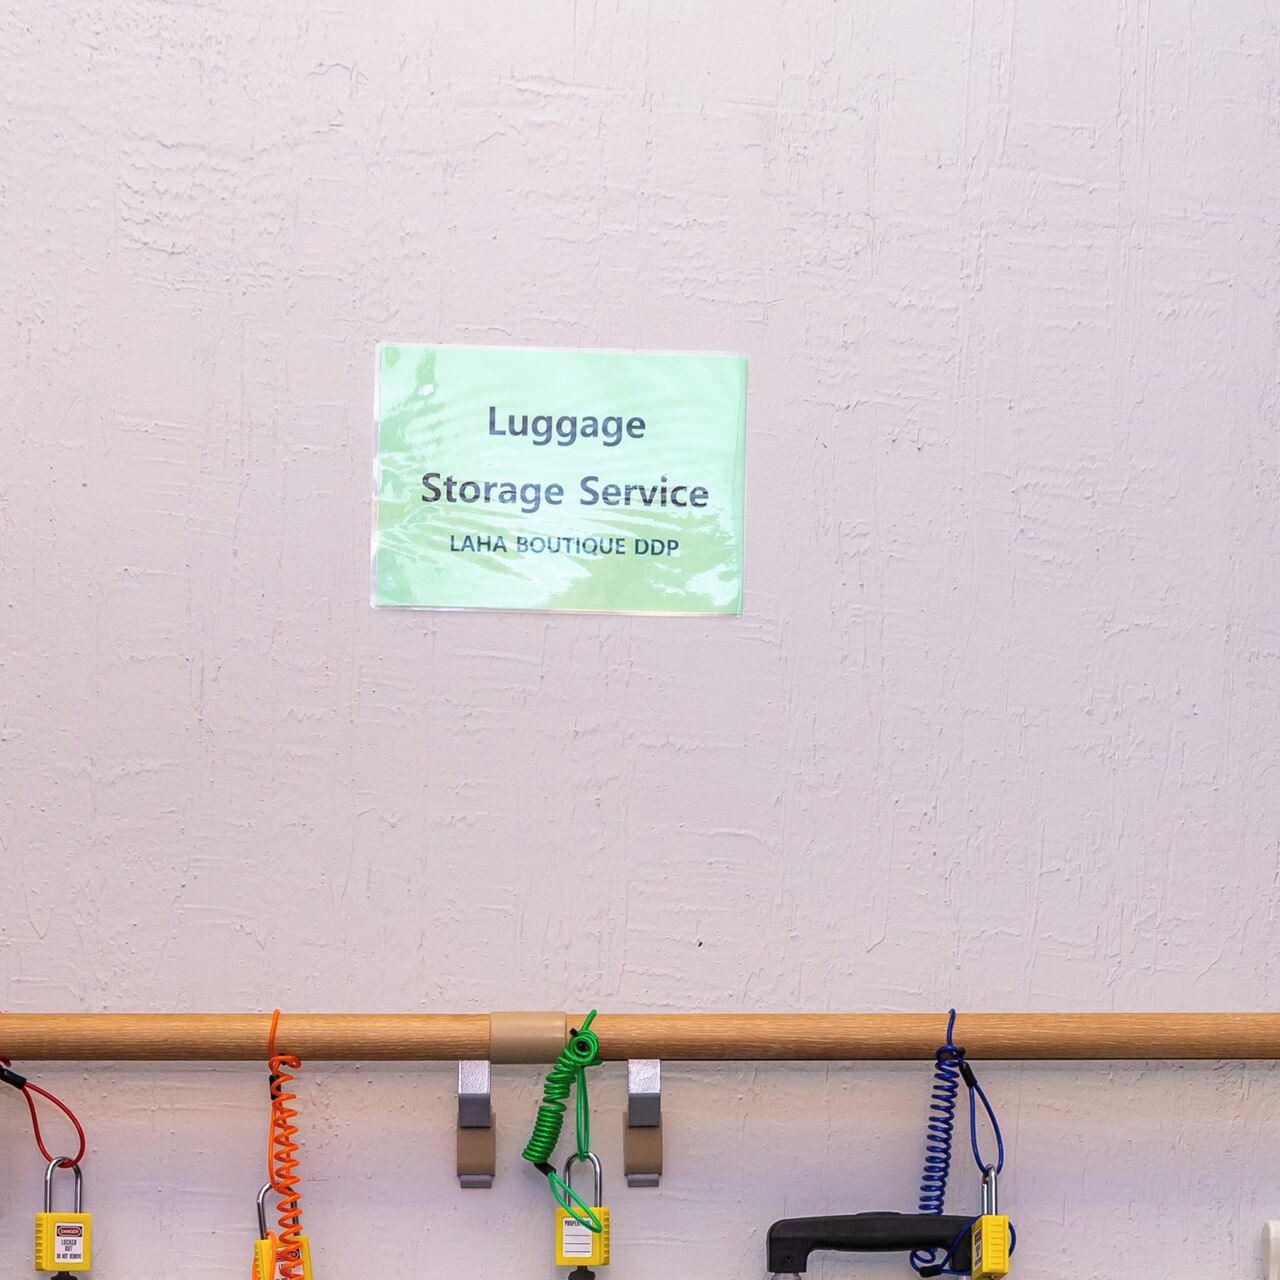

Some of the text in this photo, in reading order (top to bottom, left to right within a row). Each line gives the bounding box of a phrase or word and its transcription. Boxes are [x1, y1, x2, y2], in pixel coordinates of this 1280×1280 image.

[489, 406, 646, 447] Luggage
[421, 472, 709, 514] Storage Service
[450, 535, 680, 557] LAHA BOUTIQUE DDP
